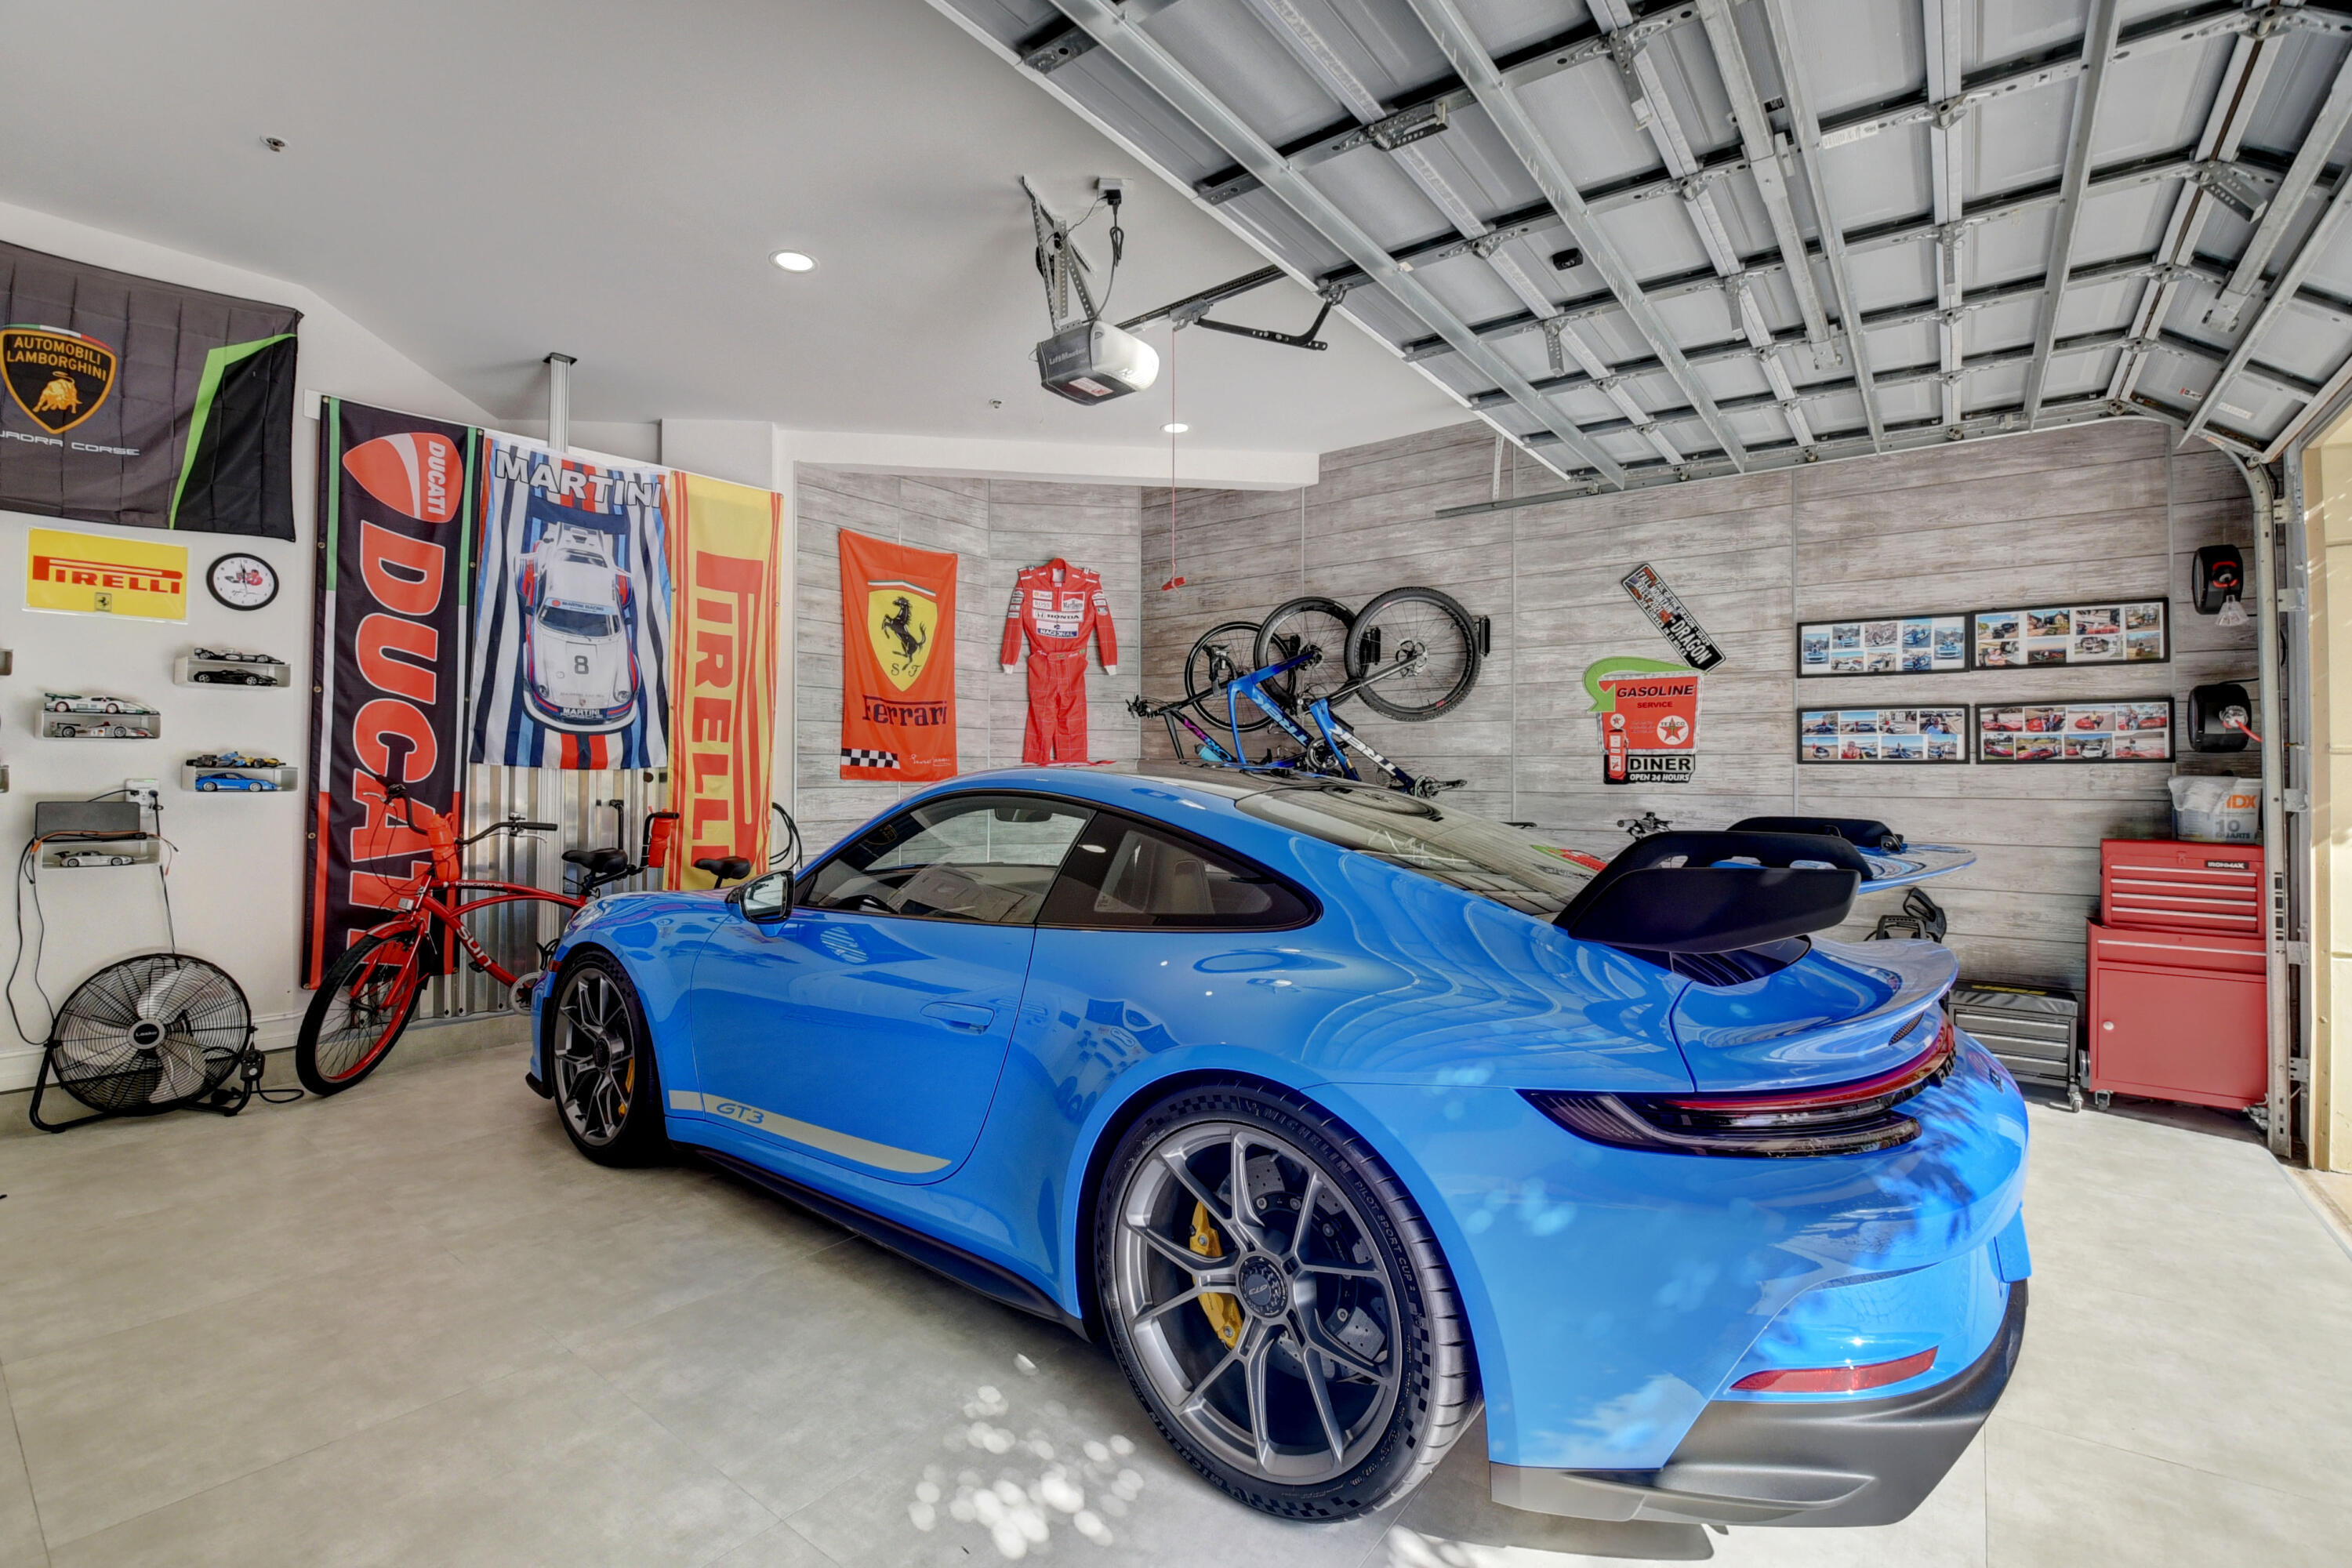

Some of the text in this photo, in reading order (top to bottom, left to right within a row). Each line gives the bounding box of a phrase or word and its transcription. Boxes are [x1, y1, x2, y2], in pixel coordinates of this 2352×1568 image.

[14, 336, 101, 365] AUTOMOBILI
[6, 350, 107, 382] LAMBORGHINI
[71, 441, 140, 456] CORSE
[427, 440, 446, 516] DUCATI
[495, 448, 662, 509] MARTINI
[33, 555, 183, 594] PIRELLI
[1635, 581, 1653, 601] RALLY
[1637, 571, 1675, 615] FALL MOUNTAIN
[1040, 628, 1075, 637] NACIONAL
[1646, 607, 1665, 629] CURVES
[1671, 638, 1689, 657] MILES
[1677, 608, 1695, 629] DRAGON
[1669, 619, 1712, 666] DRAGON
[574, 655, 589, 675] 8
[891, 663, 922, 678] S F
[1617, 684, 1694, 698] GASOLINE
[563, 707, 601, 716] MARTINI
[862, 695, 947, 727] Ferrari
[1252, 694, 1308, 748] TREK
[1330, 723, 1396, 776] TREK
[1630, 773, 1690, 782] OPEN 24 HOURS
[1631, 758, 1692, 771] DINER
[2216, 819, 2241, 833] 10
[2207, 861, 2245, 869] IRONMAX
[715, 1102, 765, 1125] GT3
[1265, 1108, 1353, 1175] MICHELIN
[1355, 1179, 1380, 1215] PILOT
[1377, 1214, 1402, 1254] SPORT
[1399, 1256, 1414, 1282] CUP
[1149, 1411, 1225, 1486] MICHELIN
